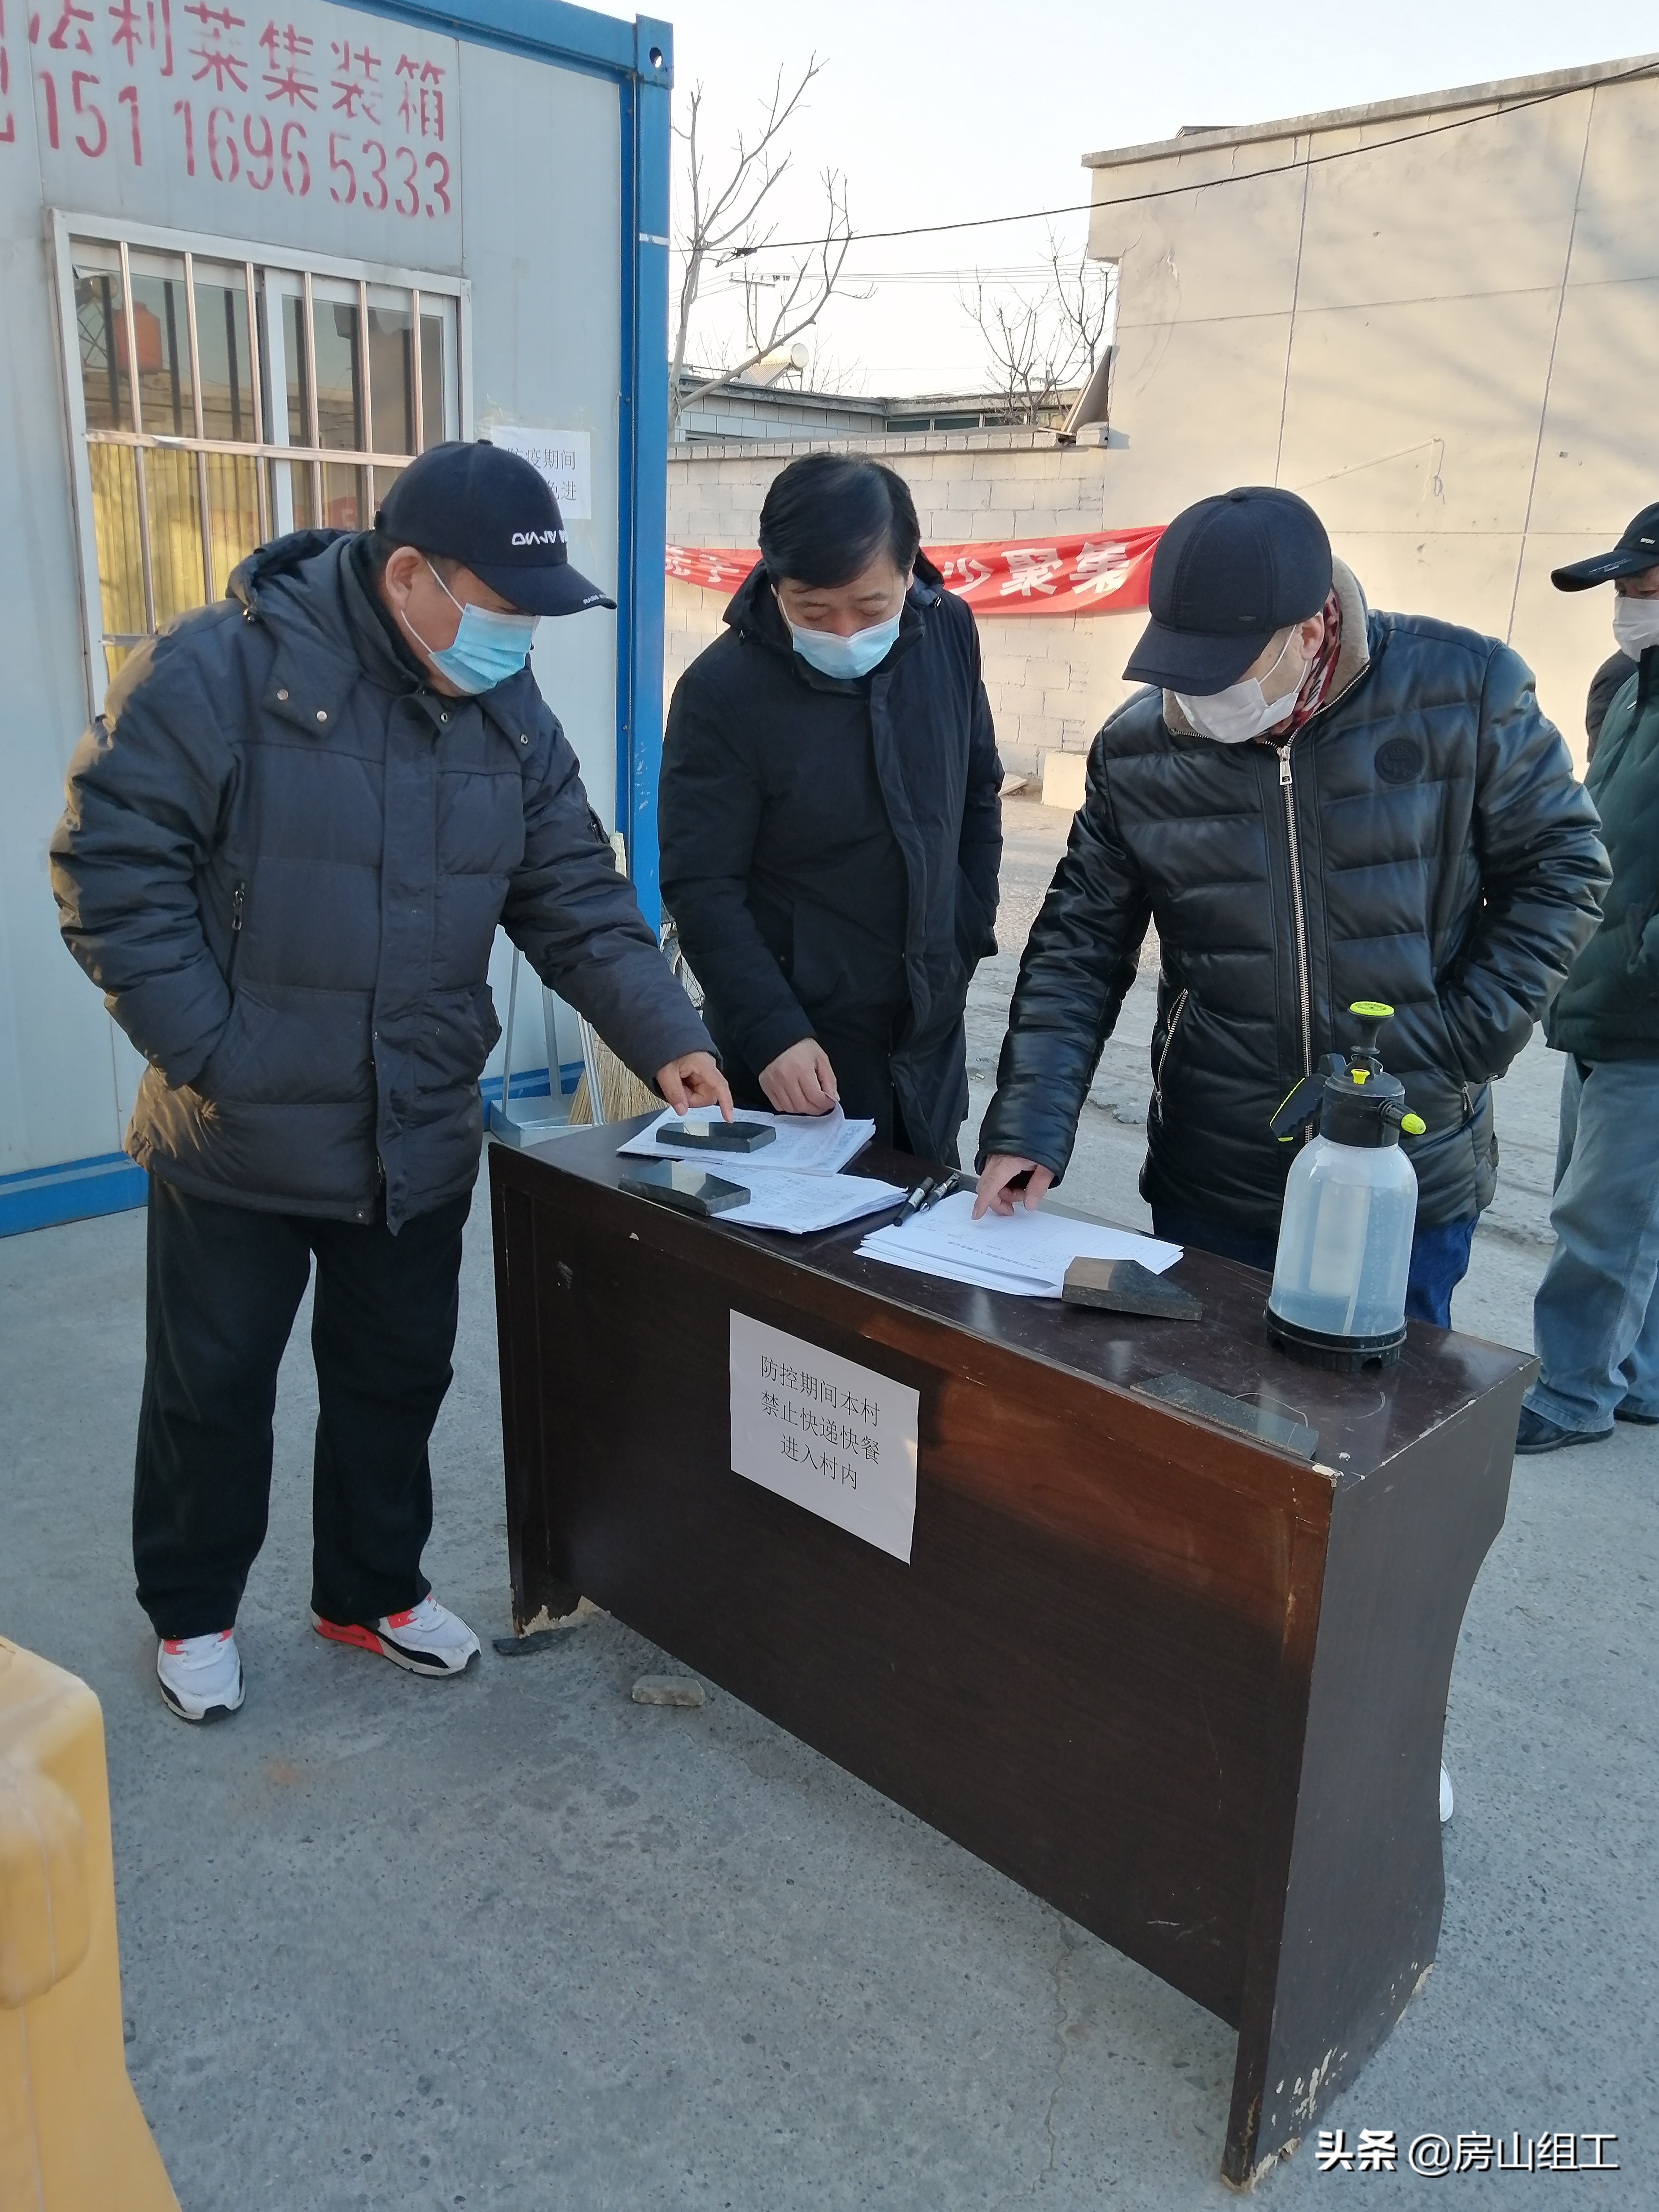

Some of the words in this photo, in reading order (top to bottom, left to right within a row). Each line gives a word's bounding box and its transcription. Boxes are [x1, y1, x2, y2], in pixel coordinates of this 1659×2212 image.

[329, 131, 451, 218] 5333
[507, 447, 575, 470] 疫期间
[943, 542, 1130, 596] 少聚集
[760, 1355, 880, 1427] 防控期间本村
[760, 1390, 880, 1465] 禁止快递快餐
[780, 1434, 858, 1491] 进入村内
